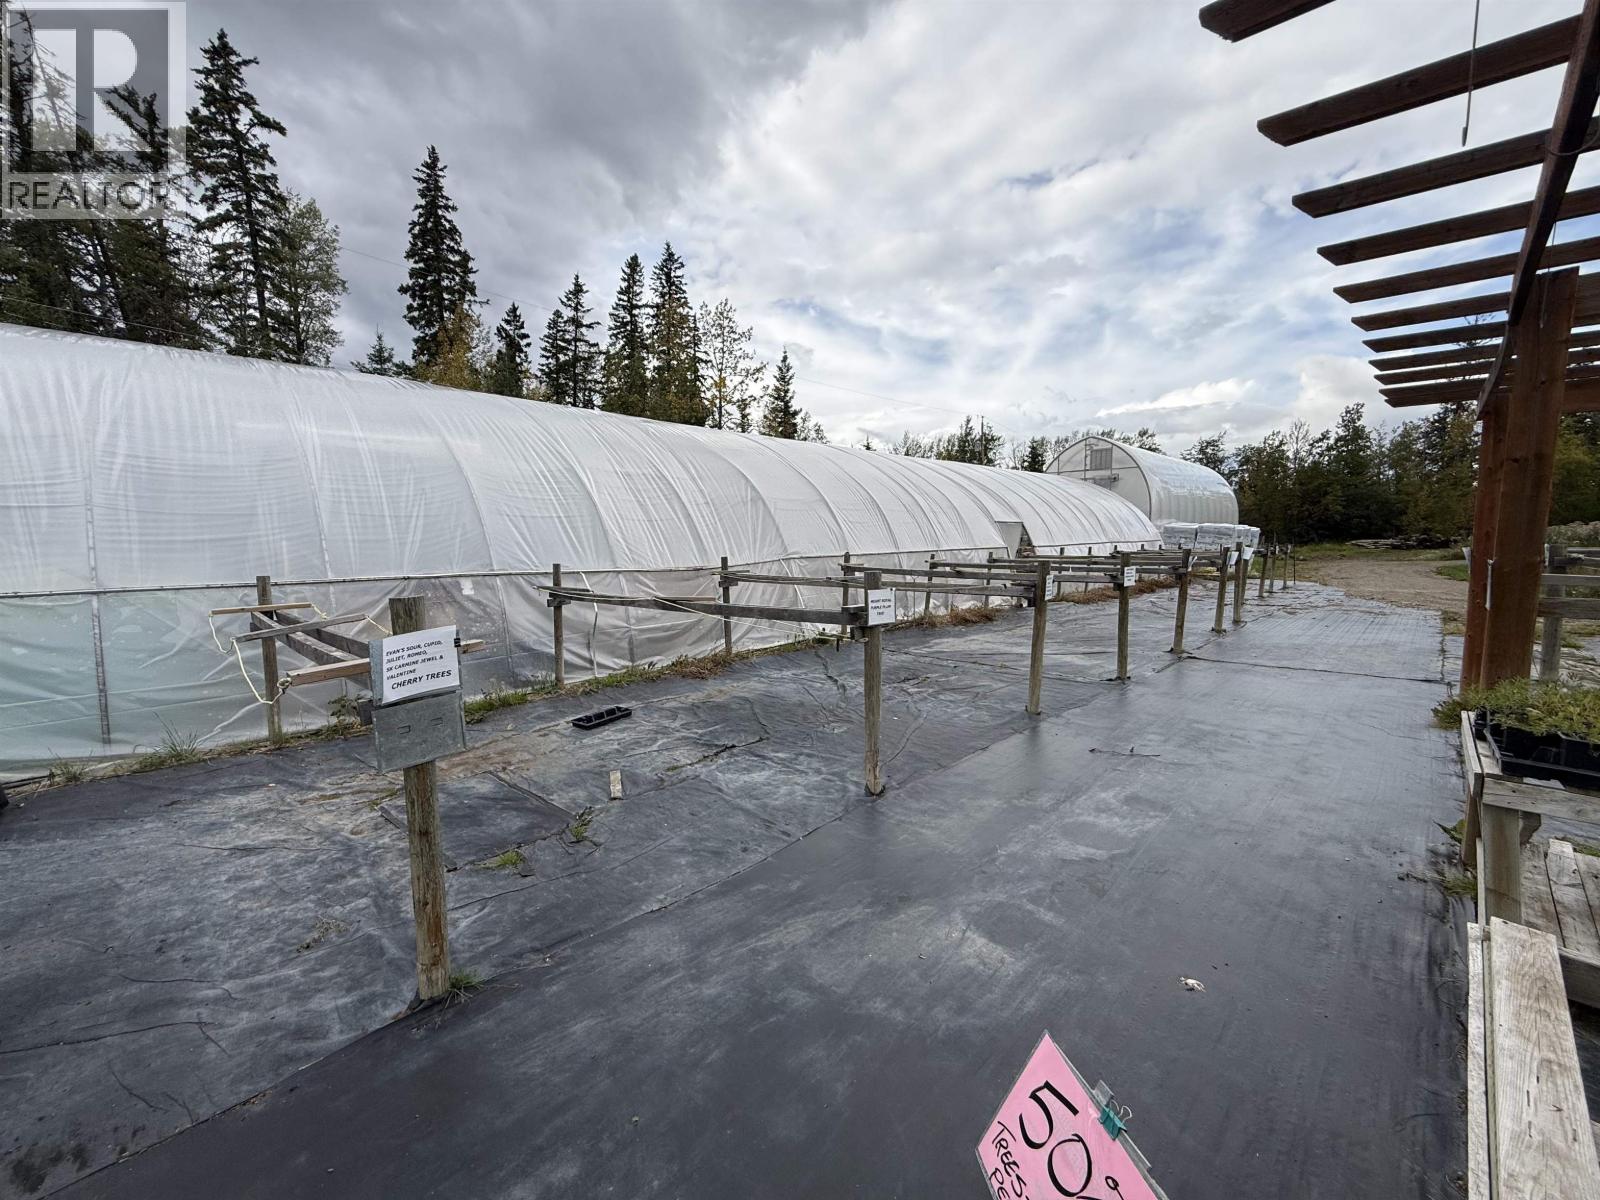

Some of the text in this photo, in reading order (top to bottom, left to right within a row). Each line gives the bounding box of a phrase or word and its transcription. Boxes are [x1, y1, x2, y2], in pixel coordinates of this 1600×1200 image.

[386, 648, 405, 656] EVAN'S
[386, 650, 428, 664] JULIET, ROMEO,
[395, 660, 419, 669] CARMINE
[387, 669, 416, 680] VALENTINE
[392, 670, 452, 690] CHERRY TREES
